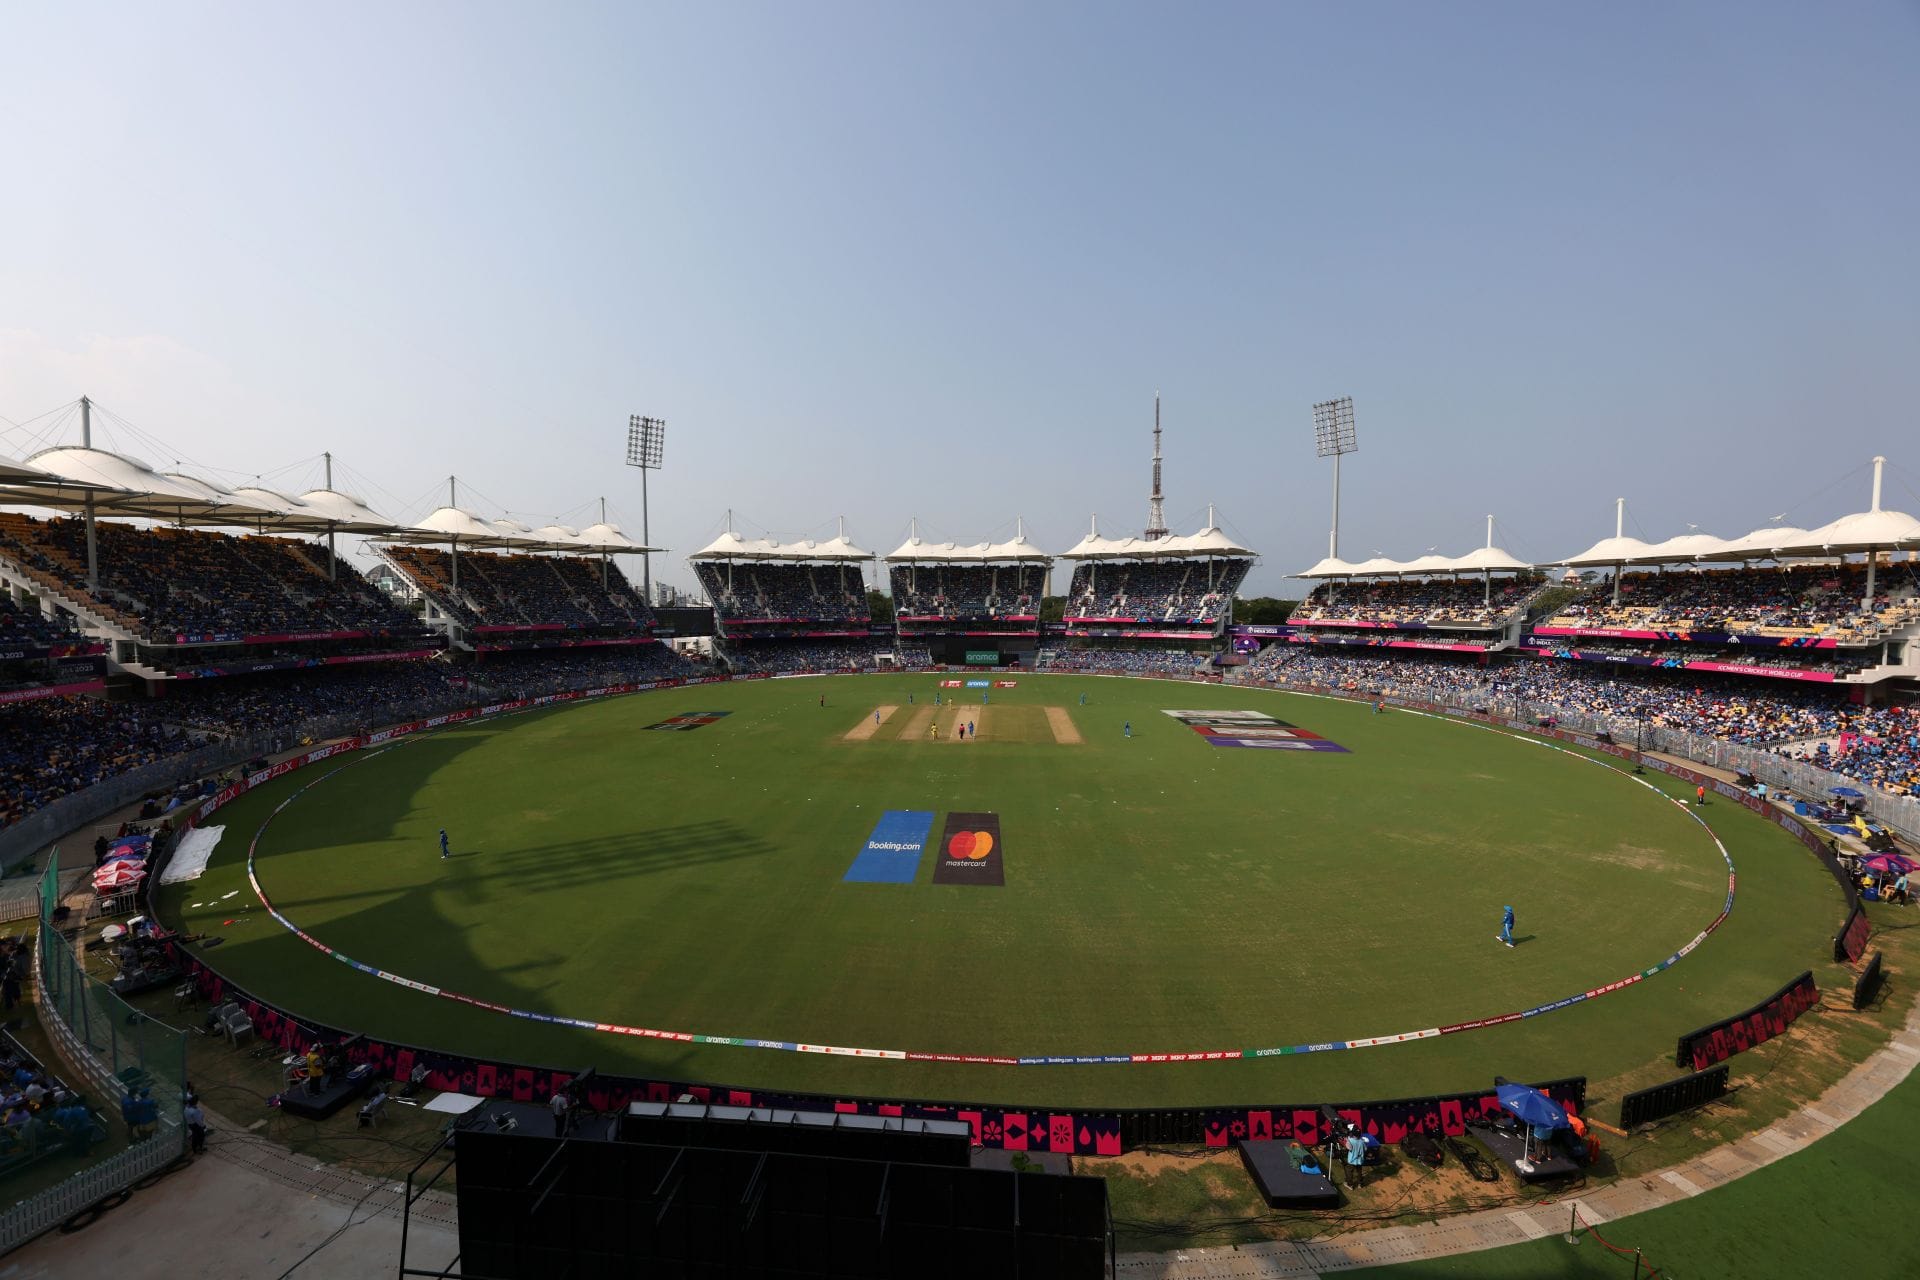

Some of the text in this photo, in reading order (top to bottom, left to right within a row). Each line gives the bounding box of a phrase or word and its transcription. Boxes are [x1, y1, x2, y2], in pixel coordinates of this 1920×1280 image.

[6, 651, 24, 659] 2023
[966, 653, 998, 661] aramco
[1744, 667, 1768, 675] CRICKET
[481, 704, 502, 716] MRF
[426, 711, 469, 728] MRF ZLX
[370, 724, 414, 744] MRF ZLX
[308, 740, 356, 763] MRF ZLX
[249, 761, 294, 789] MRF ZLX
[1642, 755, 1696, 784] MRF ZLX
[1716, 780, 1764, 813] MRF ZLX
[201, 786, 236, 820] MRF ZLX
[1780, 813, 1804, 840] MRF
[868, 841, 921, 852] Booking.com
[706, 1036, 730, 1044] aramco
[758, 1041, 783, 1049] aramco
[1256, 1048, 1281, 1056] aramco
[1309, 1043, 1333, 1052] aramco
